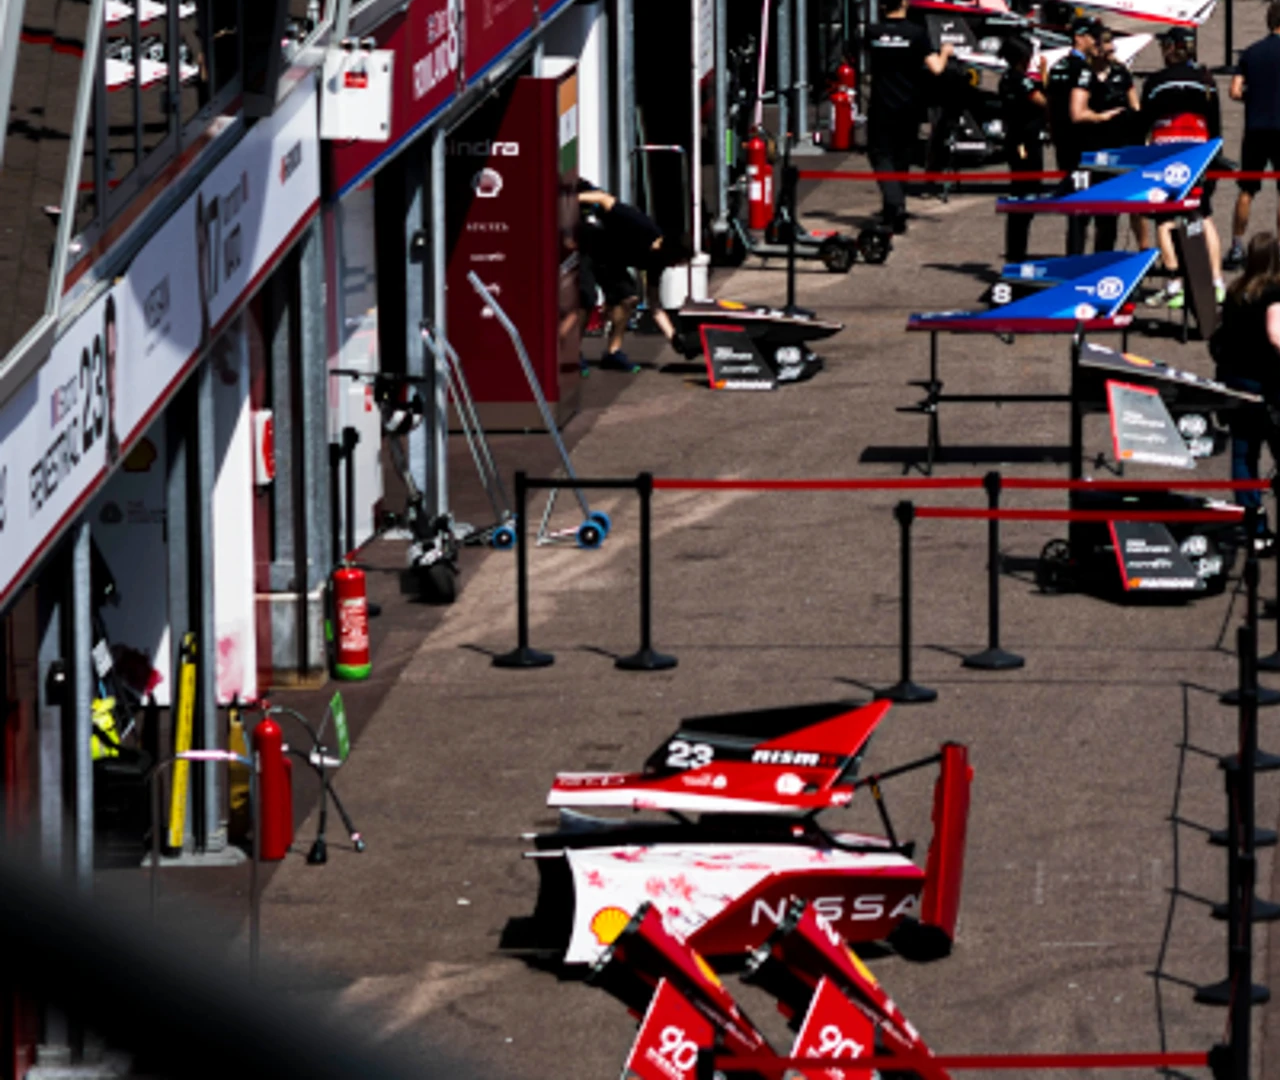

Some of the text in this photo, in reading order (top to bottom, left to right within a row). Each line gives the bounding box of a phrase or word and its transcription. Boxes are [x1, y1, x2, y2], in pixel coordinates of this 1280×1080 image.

[1071, 170, 1091, 190] 11
[991, 283, 1013, 304] 8
[80, 334, 105, 453] 23
[665, 740, 714, 770] 23
[751, 894, 919, 926] NSSA
[659, 1024, 699, 1071] 90
